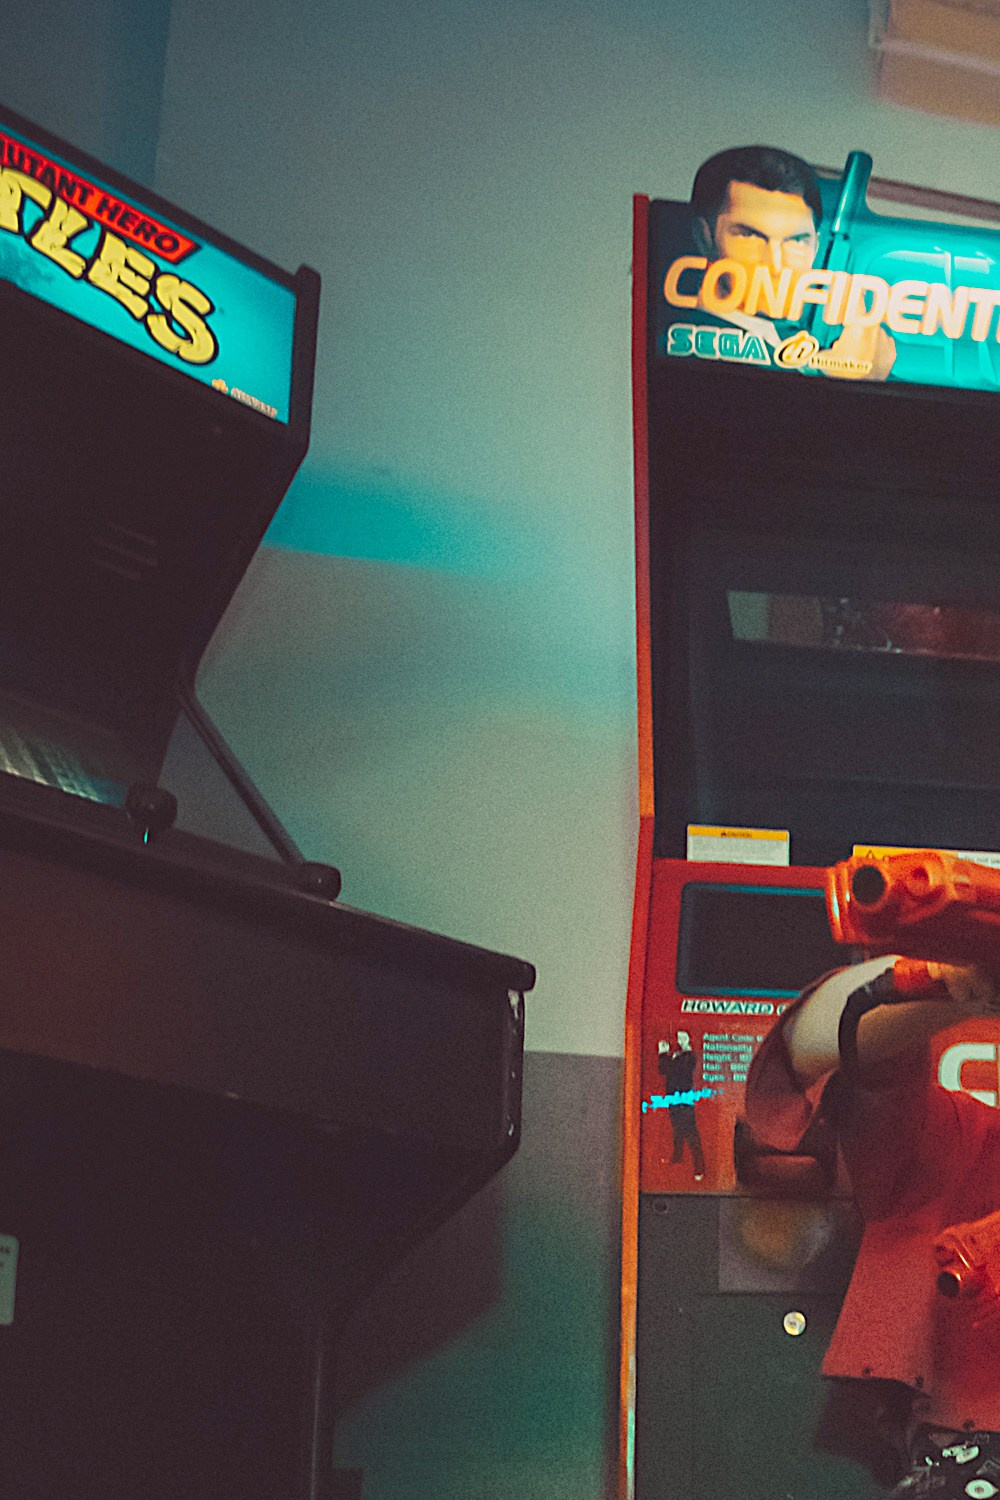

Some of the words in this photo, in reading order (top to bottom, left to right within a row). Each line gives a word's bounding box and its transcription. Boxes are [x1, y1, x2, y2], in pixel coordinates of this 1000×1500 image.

[0, 140, 95, 206] UTANT
[96, 197, 181, 254] HERO
[667, 323, 771, 366] SEGA
[809, 355, 873, 373] Hitmaker
[681, 1000, 775, 1016] HOWARD
